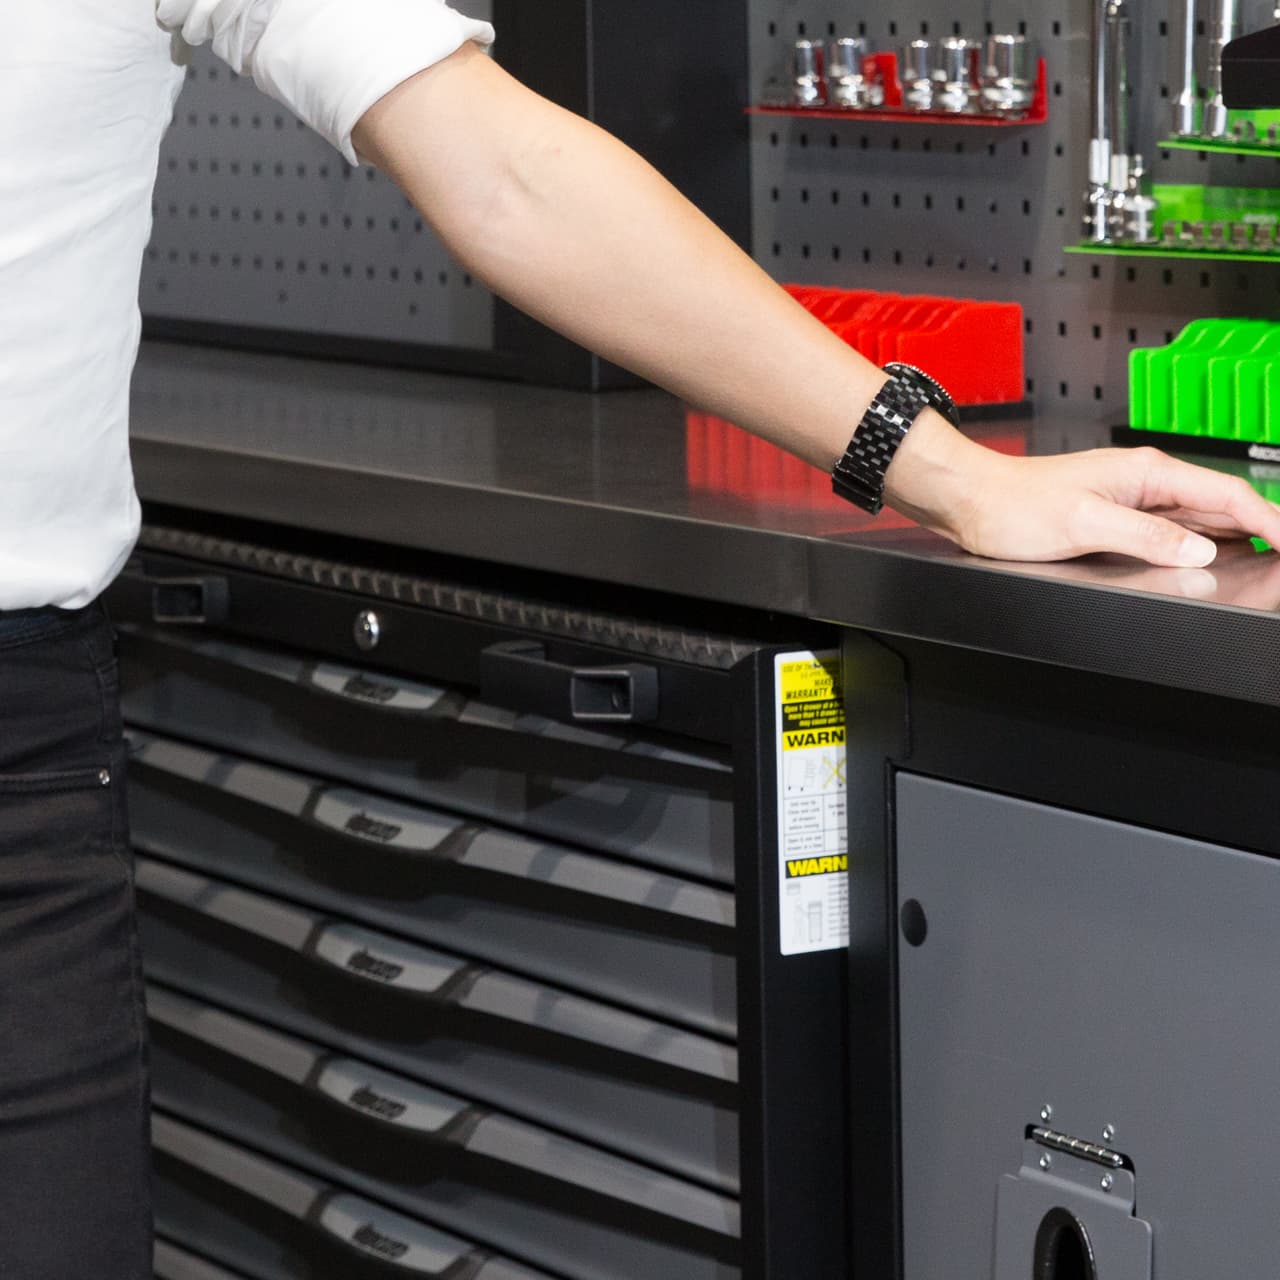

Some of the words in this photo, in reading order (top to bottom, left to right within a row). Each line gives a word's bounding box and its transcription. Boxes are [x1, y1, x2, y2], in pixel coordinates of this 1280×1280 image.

[786, 688, 828, 700] WARRANTY
[786, 729, 844, 748] WARN
[786, 855, 847, 877] WARN
